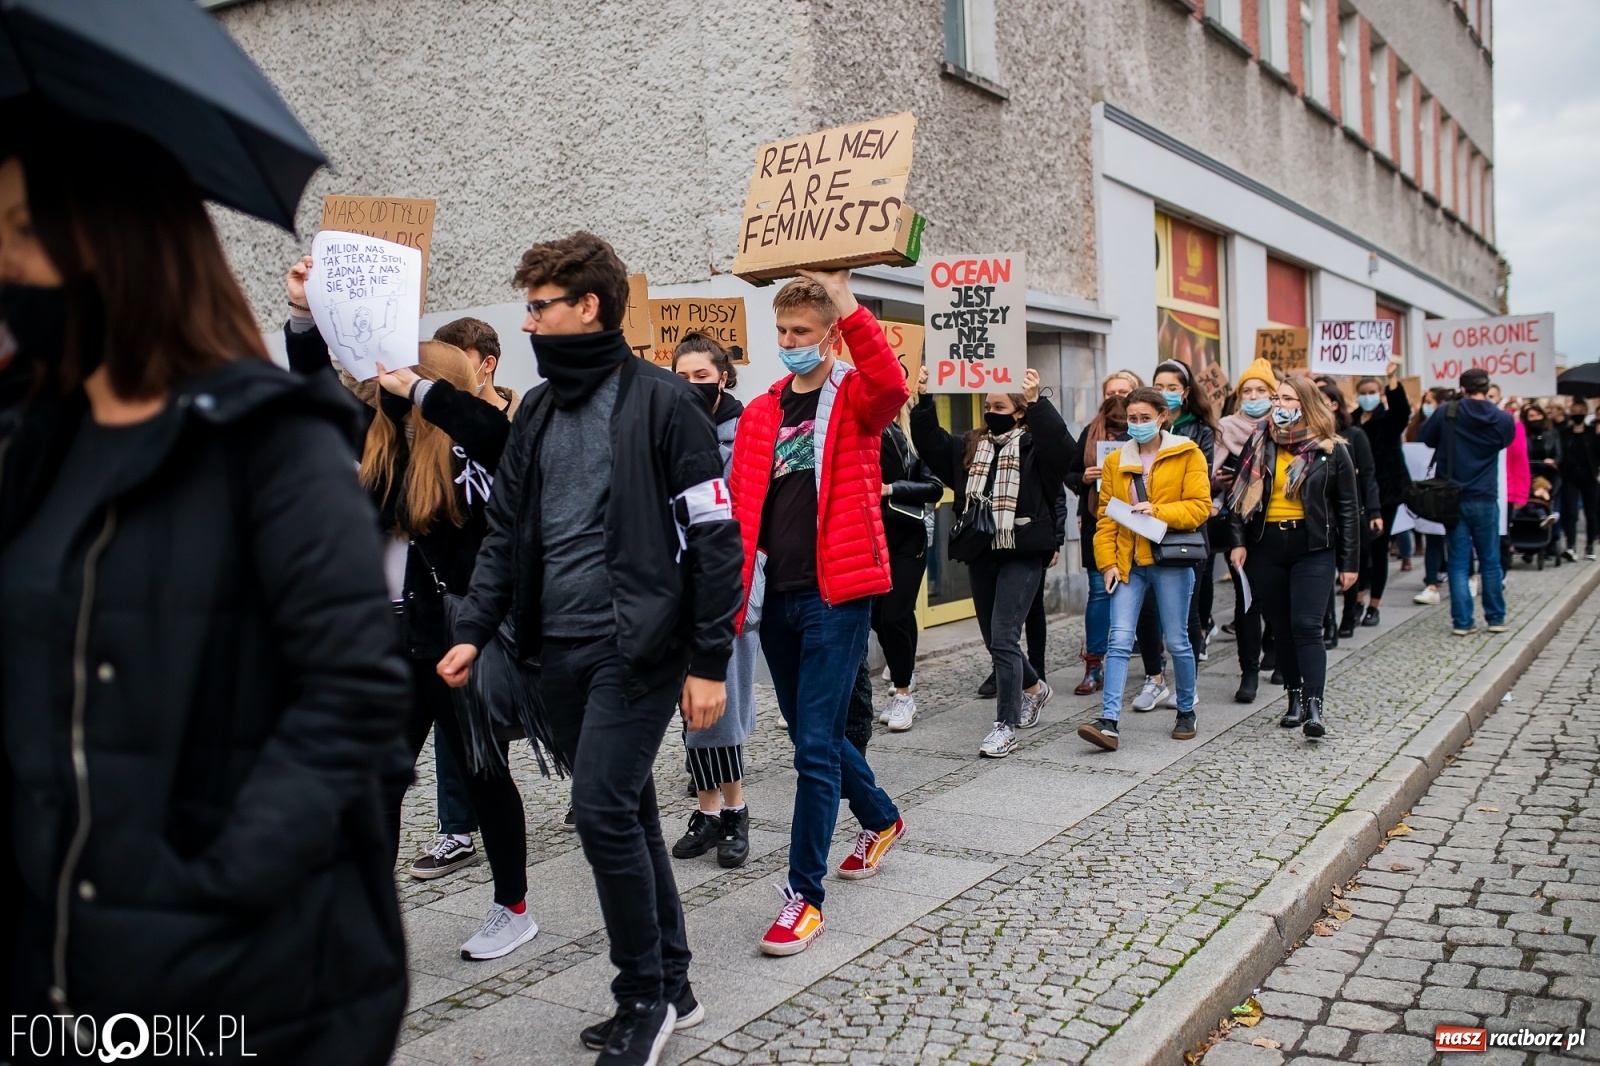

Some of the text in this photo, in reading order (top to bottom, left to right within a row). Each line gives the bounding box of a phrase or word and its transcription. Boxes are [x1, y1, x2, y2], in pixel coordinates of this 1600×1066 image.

[760, 129, 900, 179] REAL MEN
[776, 169, 852, 213] ARE
[323, 200, 429, 225] MARS OD TYŁU
[742, 196, 901, 254] FEMINISTS
[321, 255, 341, 267] TAK
[344, 253, 379, 264] TERAZ
[326, 243, 385, 256] MILION NAS
[368, 265, 376, 274] Z
[379, 265, 401, 274] NAS
[930, 258, 1011, 289] OCEAN
[326, 279, 344, 293] SIĘ
[369, 275, 389, 285] NIE
[949, 286, 995, 309] JEST
[661, 303, 737, 323] MY PUSSY
[930, 305, 1011, 331] CZYSTSZY
[661, 325, 679, 343] MY
[1261, 330, 1295, 347] TWÓJ
[1321, 321, 1393, 341] MOJE CIAŁO
[1426, 319, 1541, 349] W OBRONIE
[949, 342, 996, 364] RĘCE
[1320, 342, 1392, 364] MÓJ WYBÓR
